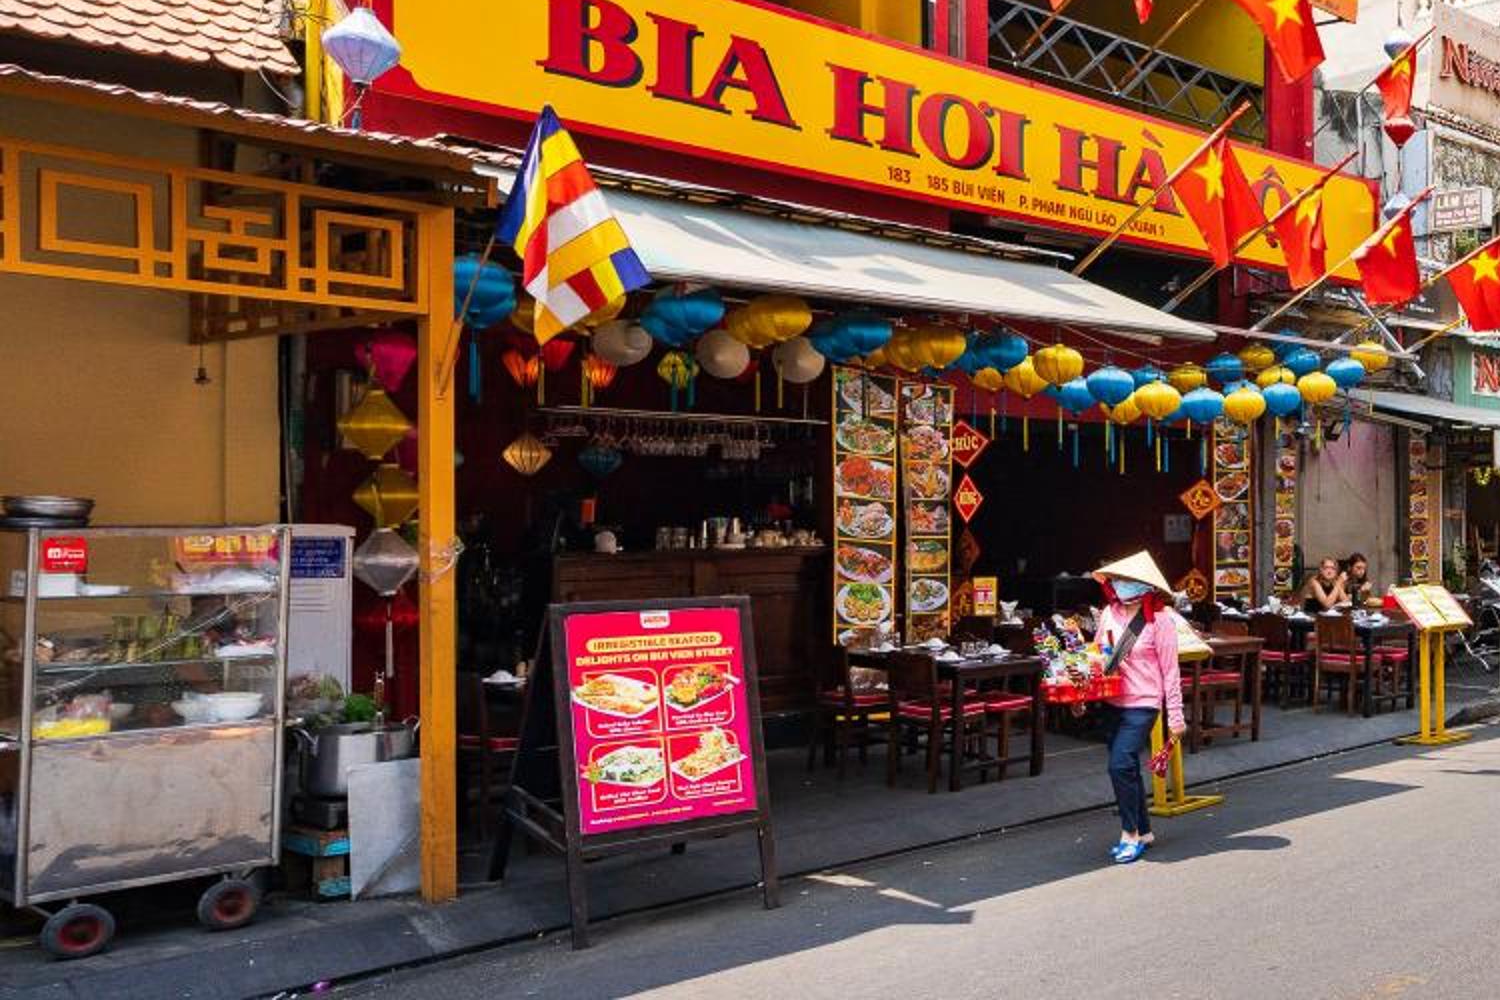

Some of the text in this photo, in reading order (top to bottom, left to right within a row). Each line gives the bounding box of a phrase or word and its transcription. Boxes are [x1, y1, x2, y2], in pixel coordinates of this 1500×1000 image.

[887, 166, 911, 184] 183
[928, 175, 949, 192] 185
[1019, 195, 1028, 209] P.
[1053, 128, 1185, 218] HÀ
[594, 635, 717, 651] IRRESISTIBLE SEAFOOD
[576, 653, 631, 666] DELIGHTS
[633, 653, 649, 663] ON
